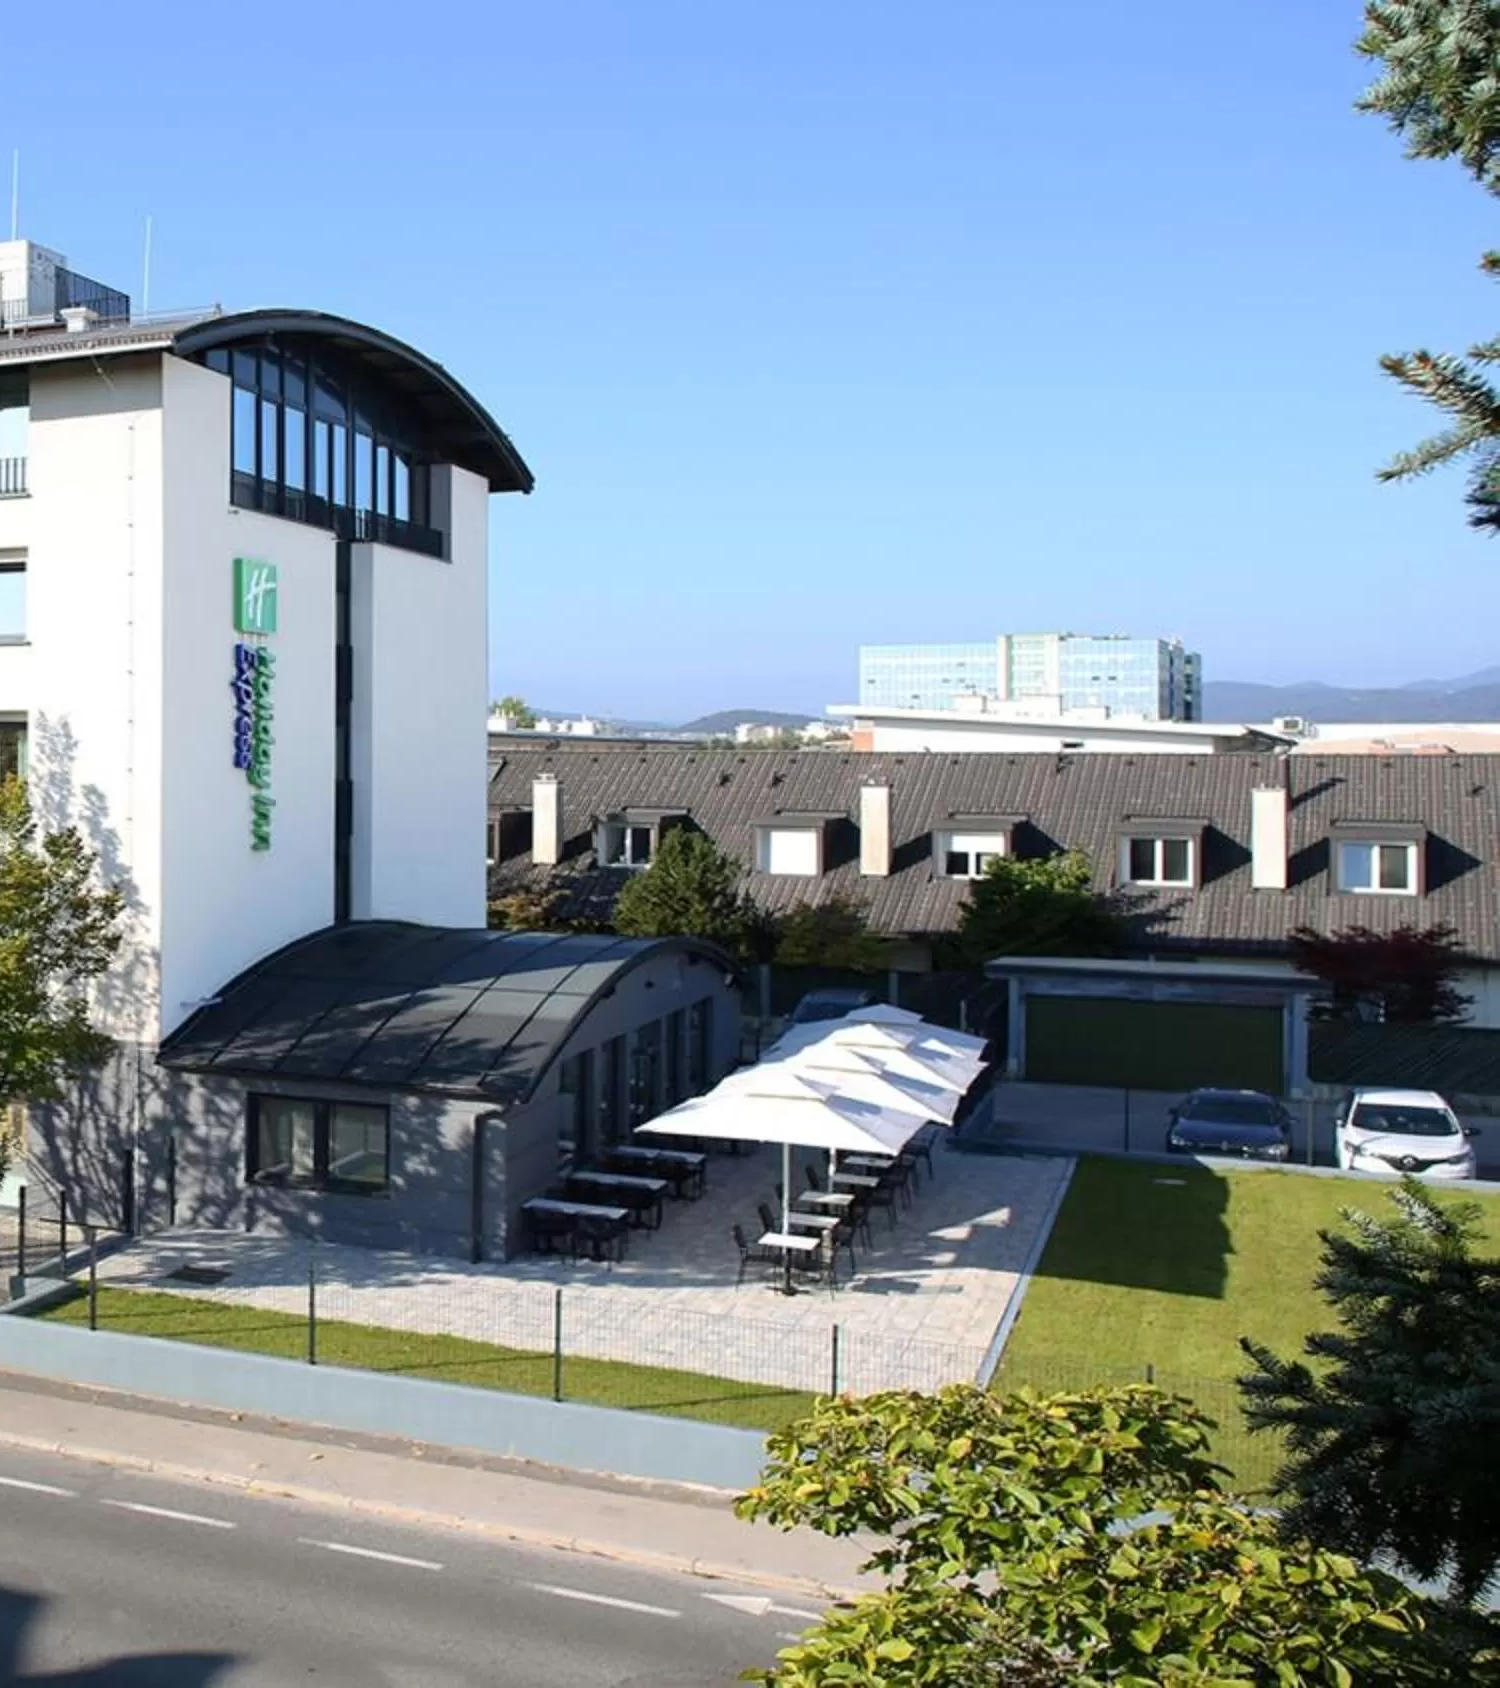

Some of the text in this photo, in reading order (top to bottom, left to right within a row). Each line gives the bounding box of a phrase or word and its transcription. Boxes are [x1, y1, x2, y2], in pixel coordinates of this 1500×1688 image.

[229, 643, 256, 769] Express
[245, 646, 276, 852] Holiday Inn
